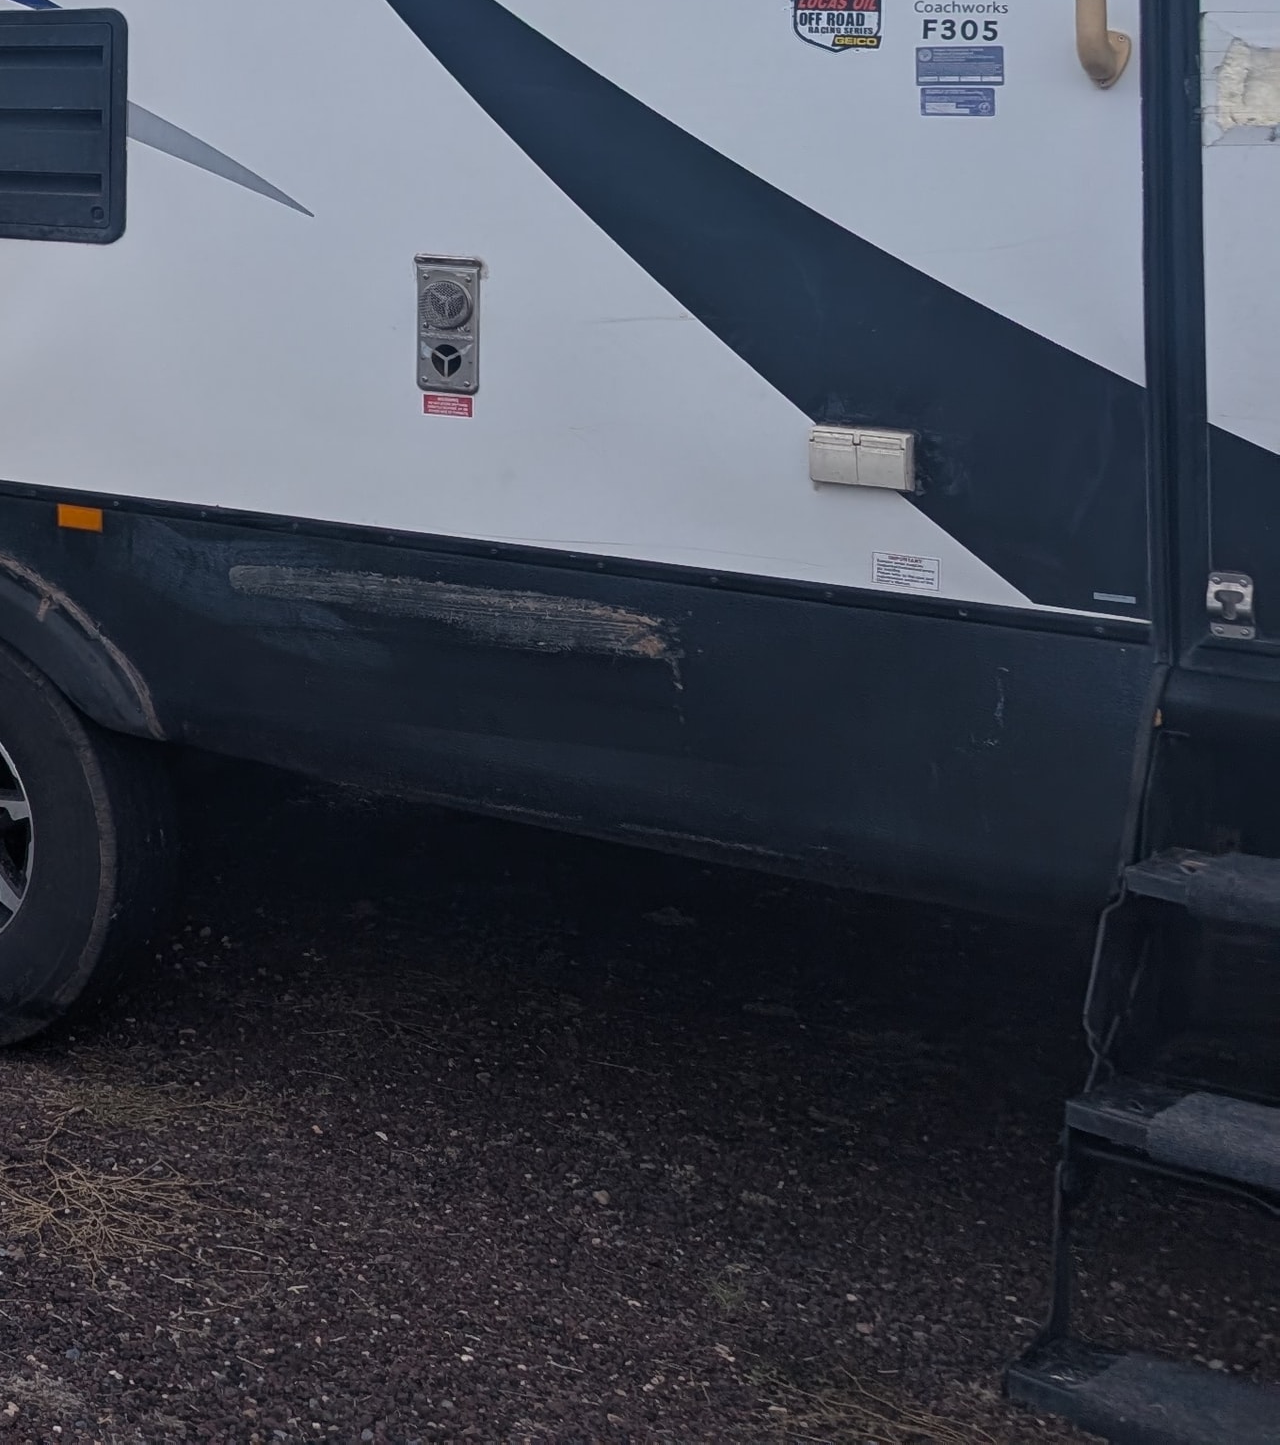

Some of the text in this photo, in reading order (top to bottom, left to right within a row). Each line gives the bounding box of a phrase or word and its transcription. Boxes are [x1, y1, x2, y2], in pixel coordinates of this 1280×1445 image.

[914, 0, 1009, 14] Coachworks
[799, 12, 865, 27] OFF ROAD
[808, 26, 874, 35] RACING SERIES
[921, 18, 999, 41] F305
[834, 37, 877, 46] GEICO
